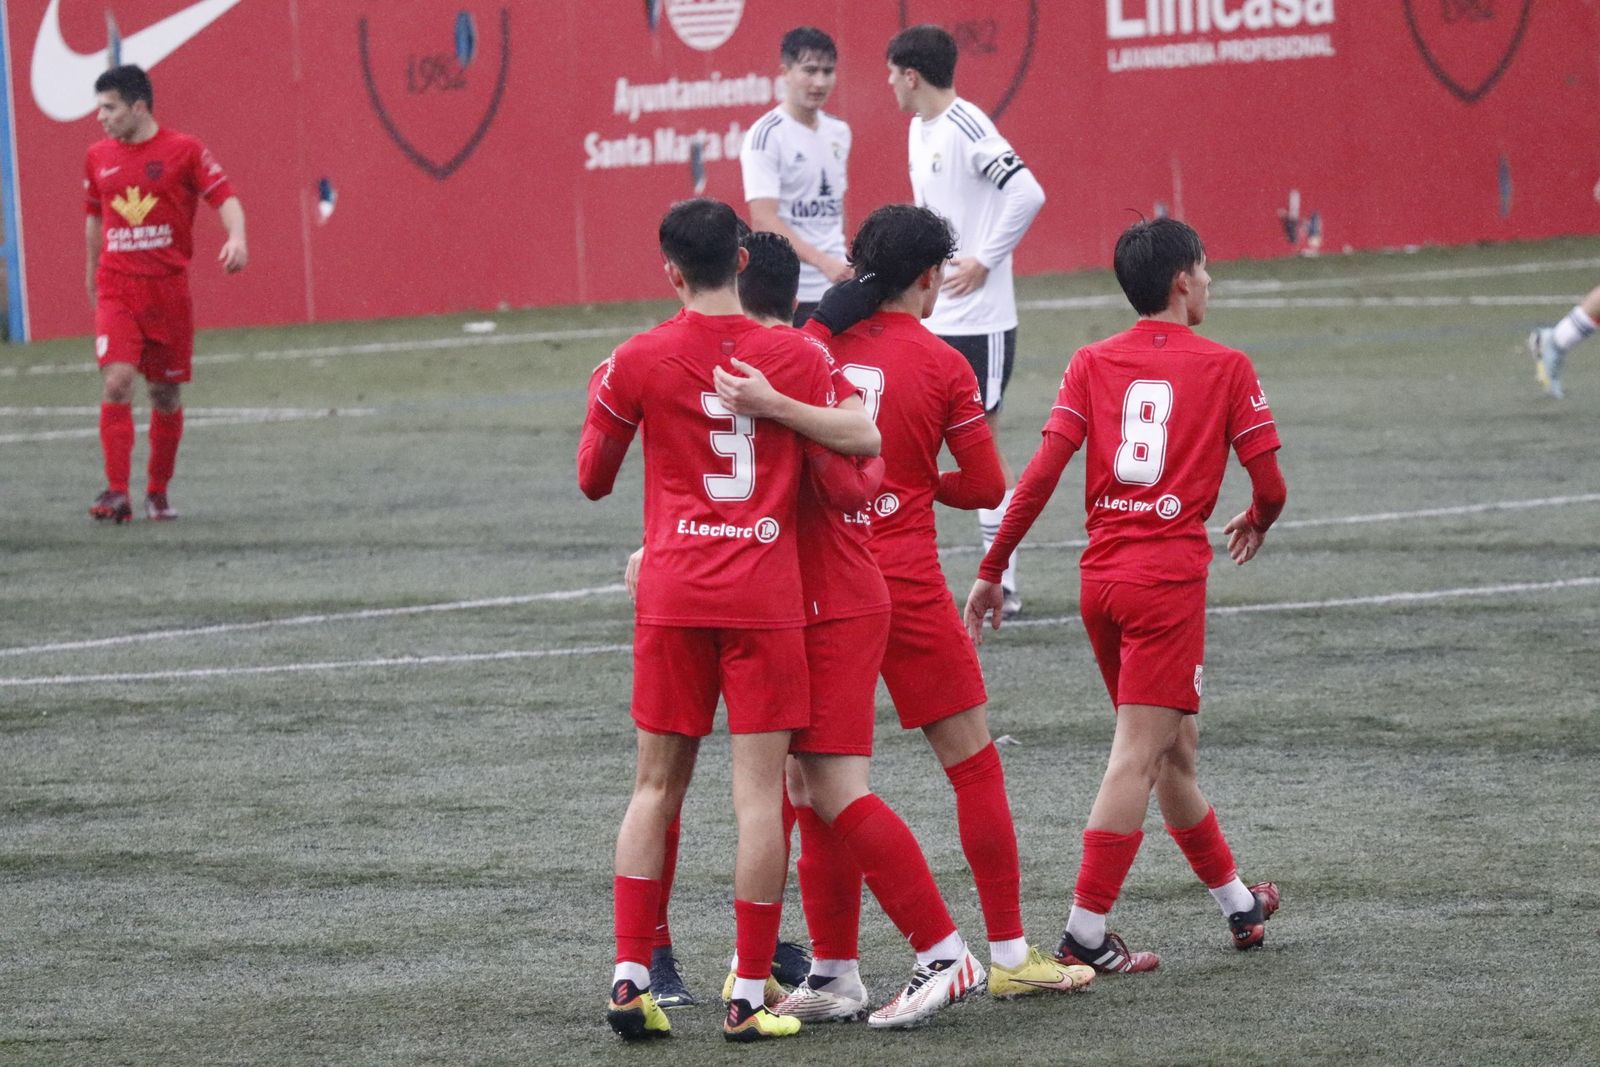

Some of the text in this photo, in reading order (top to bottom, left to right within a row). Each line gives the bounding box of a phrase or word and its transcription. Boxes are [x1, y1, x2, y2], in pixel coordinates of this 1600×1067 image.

[613, 71, 772, 123] Ayuntamiento
[583, 131, 651, 170] Santa
[653, 127, 722, 164] Marta
[701, 391, 755, 501] 3
[1114, 379, 1173, 487] 8
[677, 519, 753, 538] E.Leclerc
